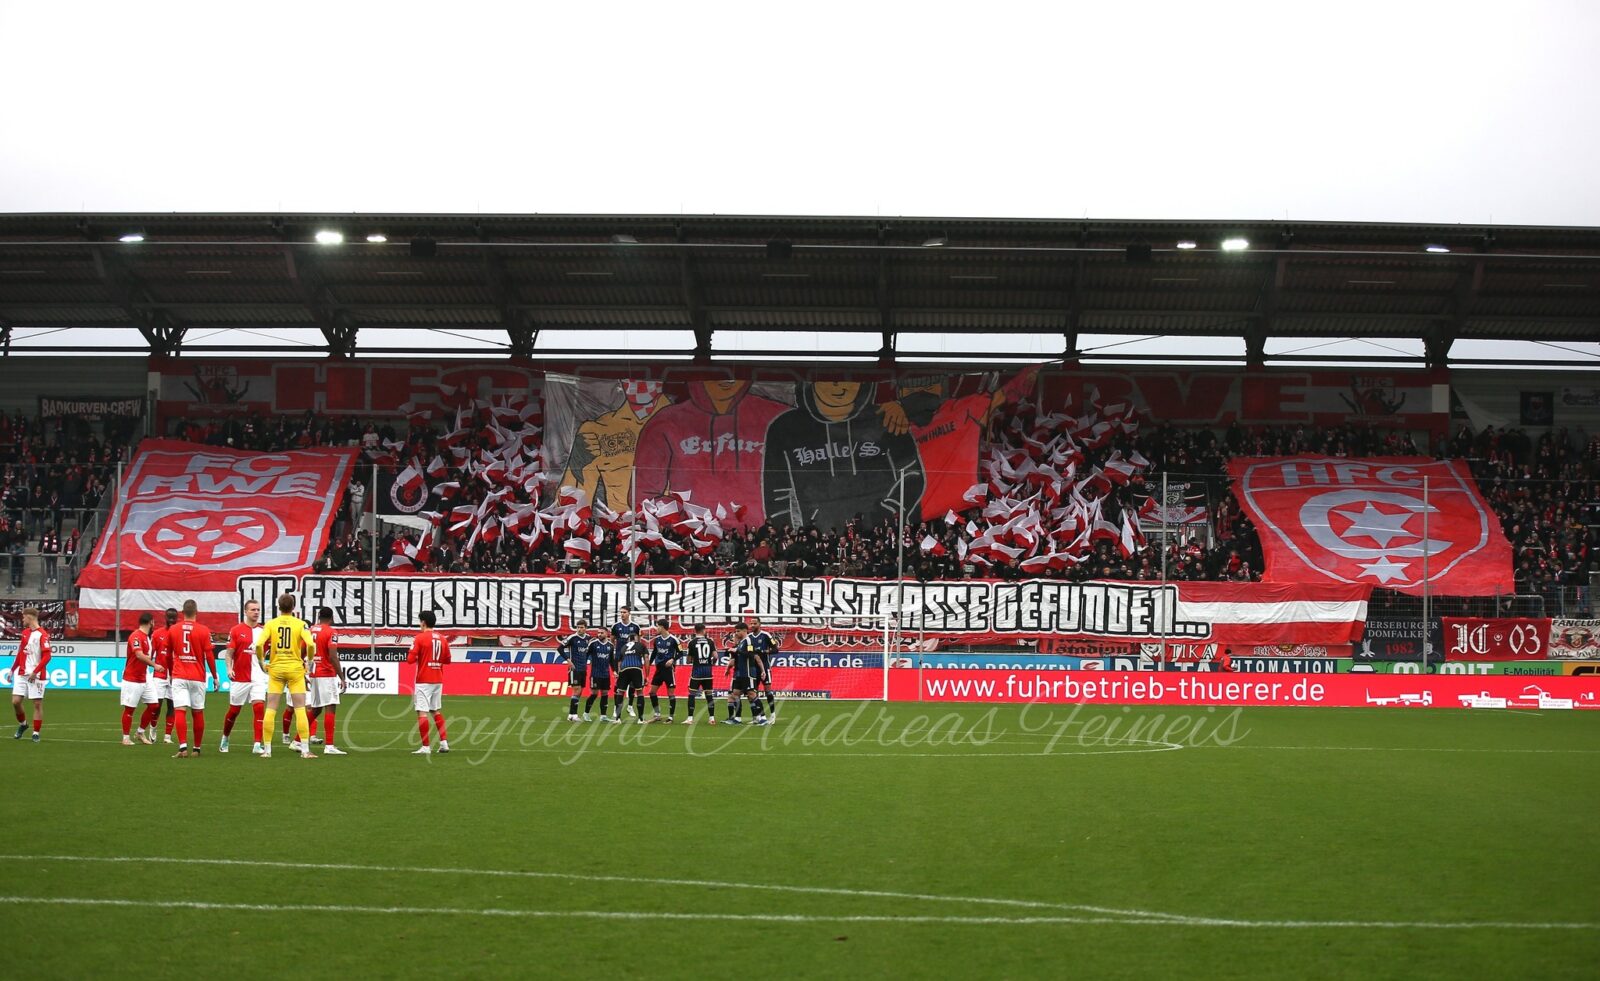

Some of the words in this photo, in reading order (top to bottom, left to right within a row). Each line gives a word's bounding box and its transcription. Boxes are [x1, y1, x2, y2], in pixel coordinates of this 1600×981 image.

[186, 454, 292, 477] FC
[1281, 463, 1422, 486] HFC
[137, 472, 321, 495] RWE
[302, 577, 564, 631] FREUNDSCHAFT
[569, 579, 676, 631] EINST
[681, 578, 748, 630] AUF
[750, 577, 825, 630] DER
[828, 579, 991, 635] STRASSE
[183, 631, 190, 653] 5
[278, 627, 291, 648] 30
[1509, 624, 1541, 654] 03
[337, 653, 354, 661] enz
[385, 652, 407, 661] dich!
[696, 644, 711, 659] 10
[1386, 643, 1415, 656] 1982
[489, 665, 535, 673] Fuhrbetrieb
[926, 674, 1325, 702] www.fuhrbetrieb-thuerer.de
